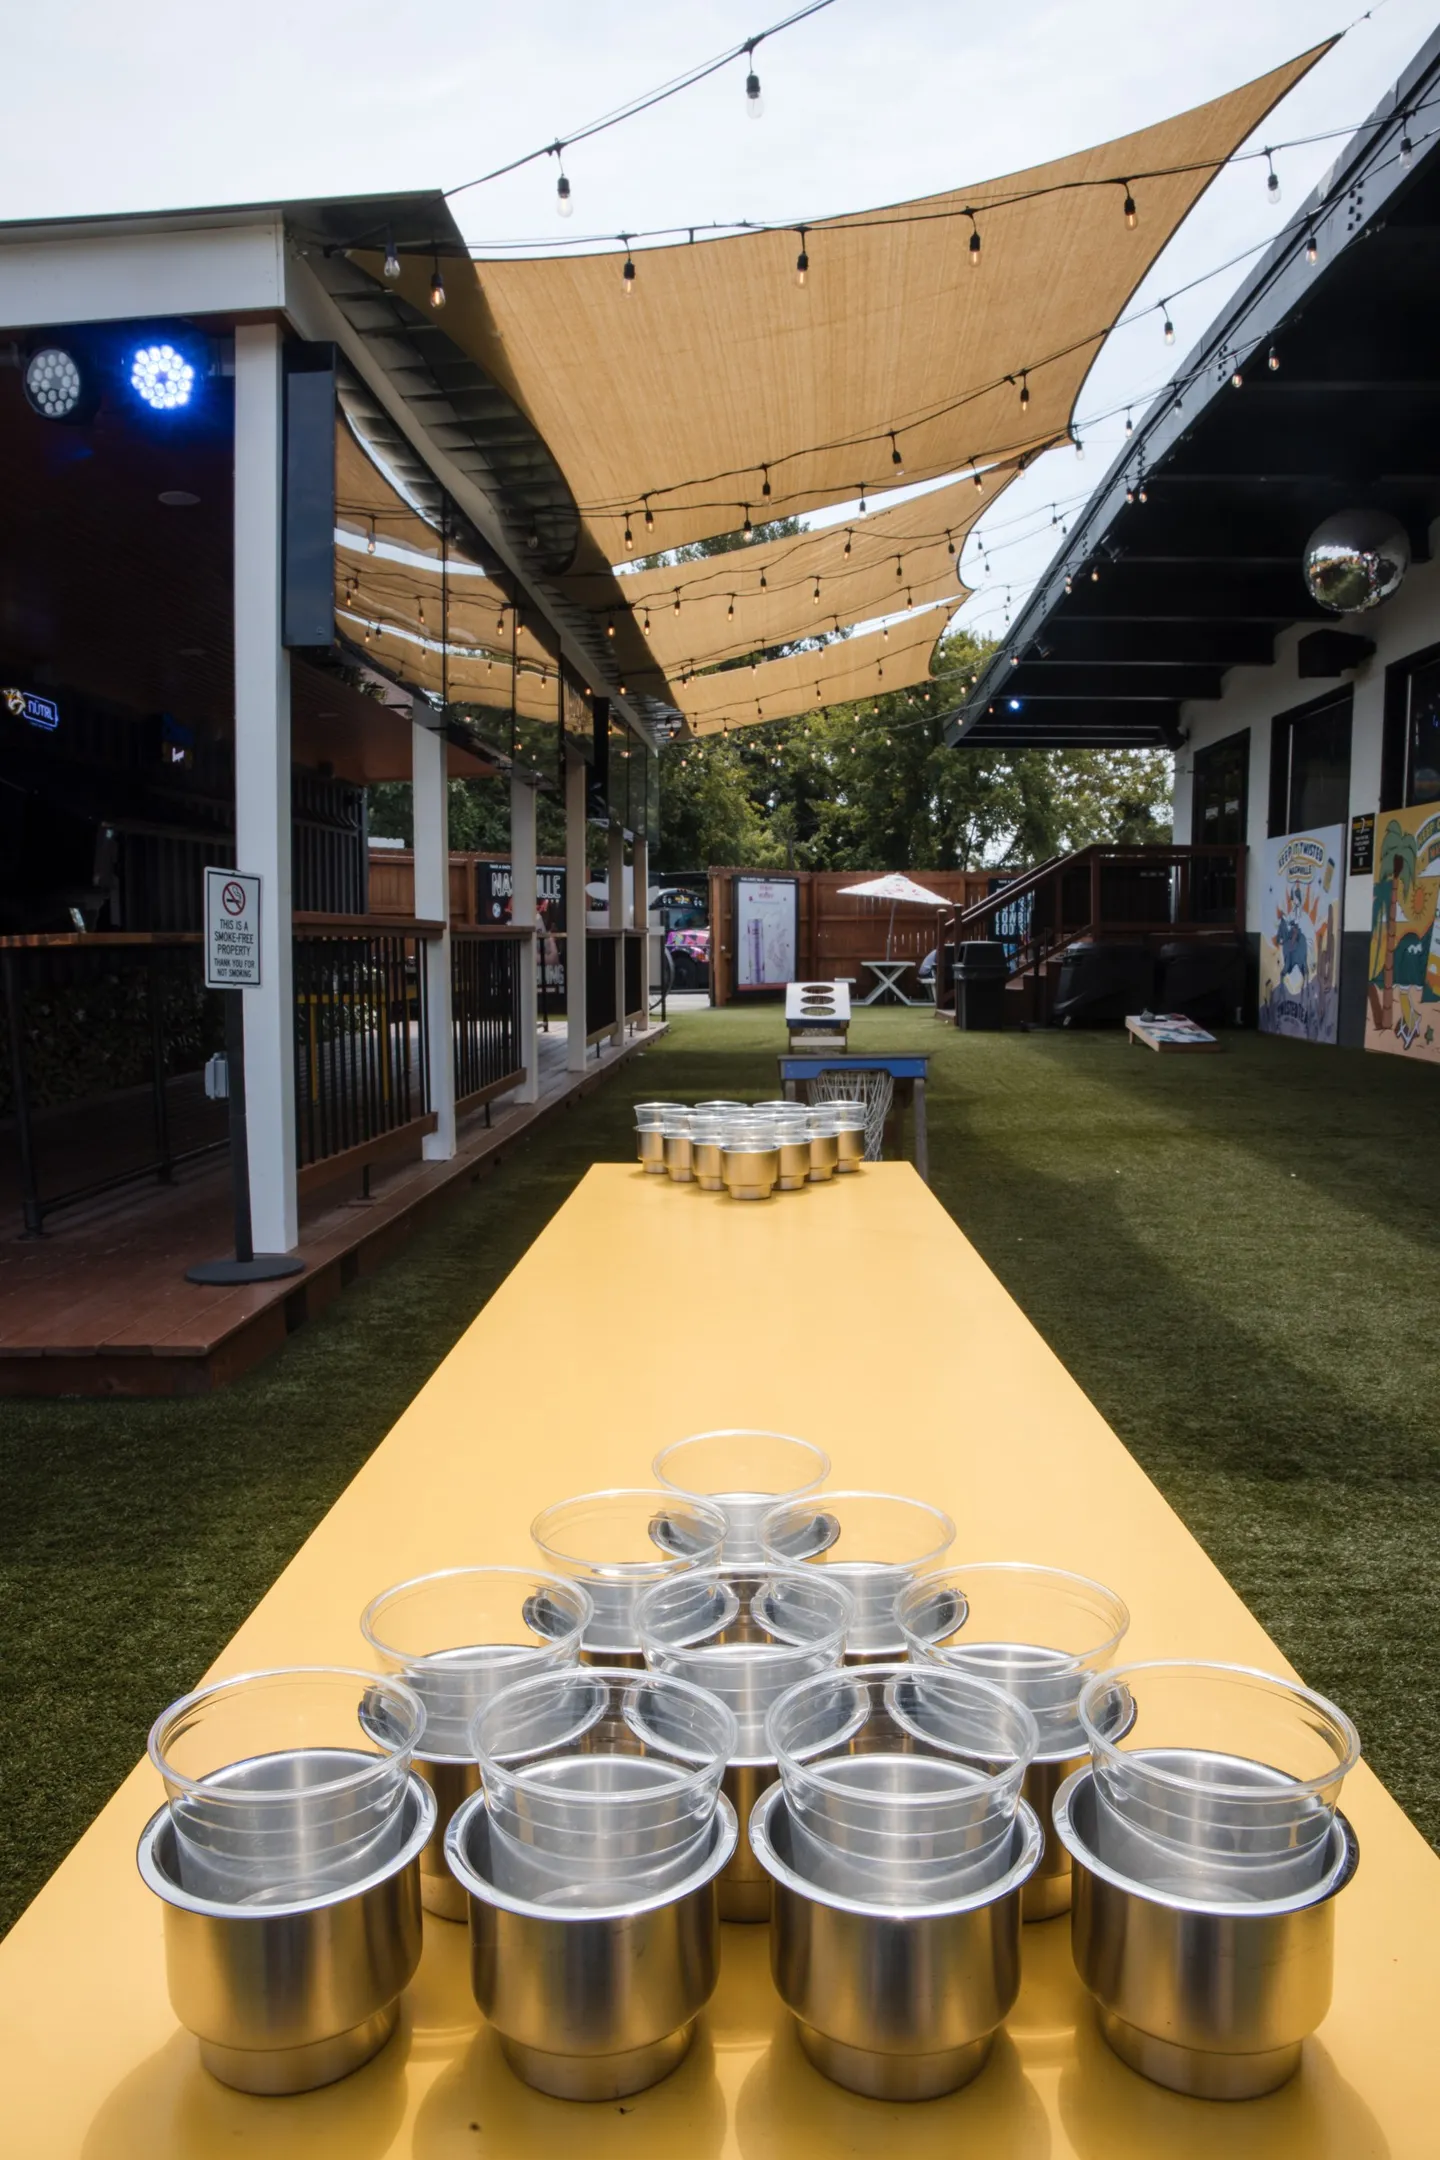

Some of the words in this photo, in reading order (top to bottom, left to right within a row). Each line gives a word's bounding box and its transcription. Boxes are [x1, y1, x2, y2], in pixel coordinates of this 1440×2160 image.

[1279, 845, 1292, 868] KEEP
[1300, 842, 1324, 862] TWISTED
[220, 919, 234, 930] THIS
[235, 921, 242, 930] IS
[244, 921, 249, 931] A
[214, 931, 254, 944] SMOKE-FREE
[217, 944, 251, 956] PROPERTY
[214, 958, 231, 967] THANK
[232, 959, 243, 968] YOU
[244, 960, 255, 969] FOR
[217, 968, 227, 977] NOT
[229, 969, 252, 978] SMOKING
